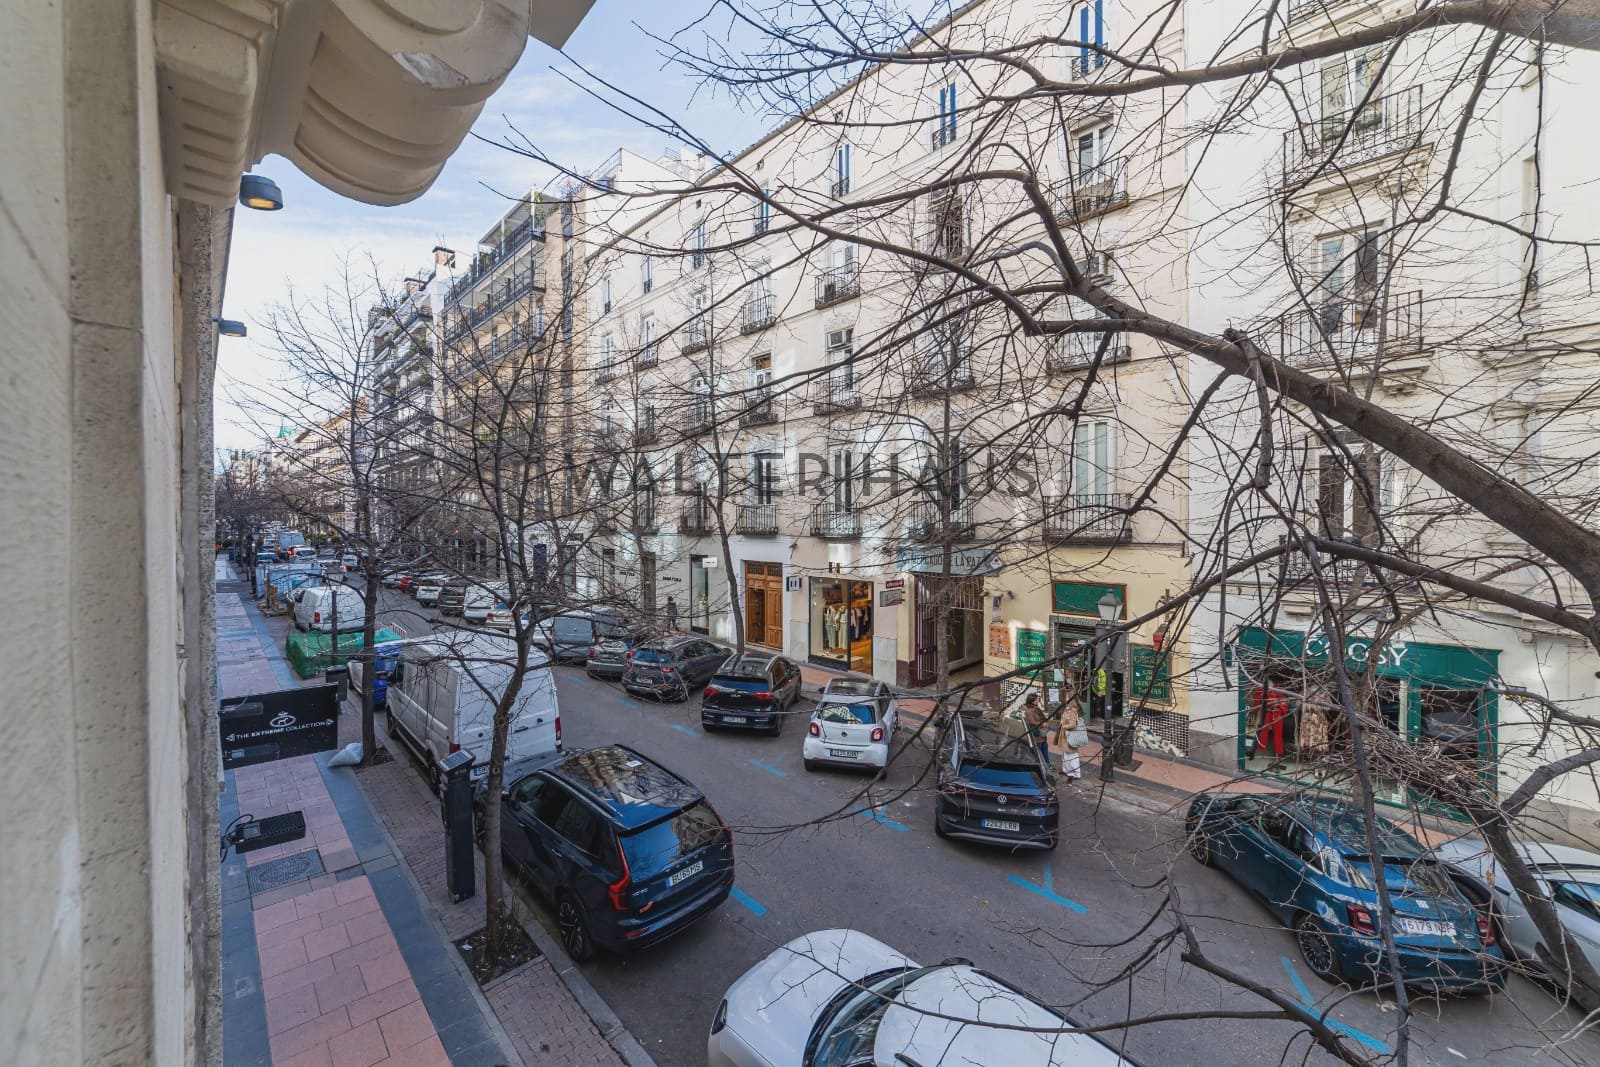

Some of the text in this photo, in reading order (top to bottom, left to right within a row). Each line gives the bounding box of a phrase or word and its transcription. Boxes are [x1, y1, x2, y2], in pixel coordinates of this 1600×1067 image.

[1305, 638, 1408, 667] COSY
[236, 721, 326, 740] THE EXTREME COLLECTION
